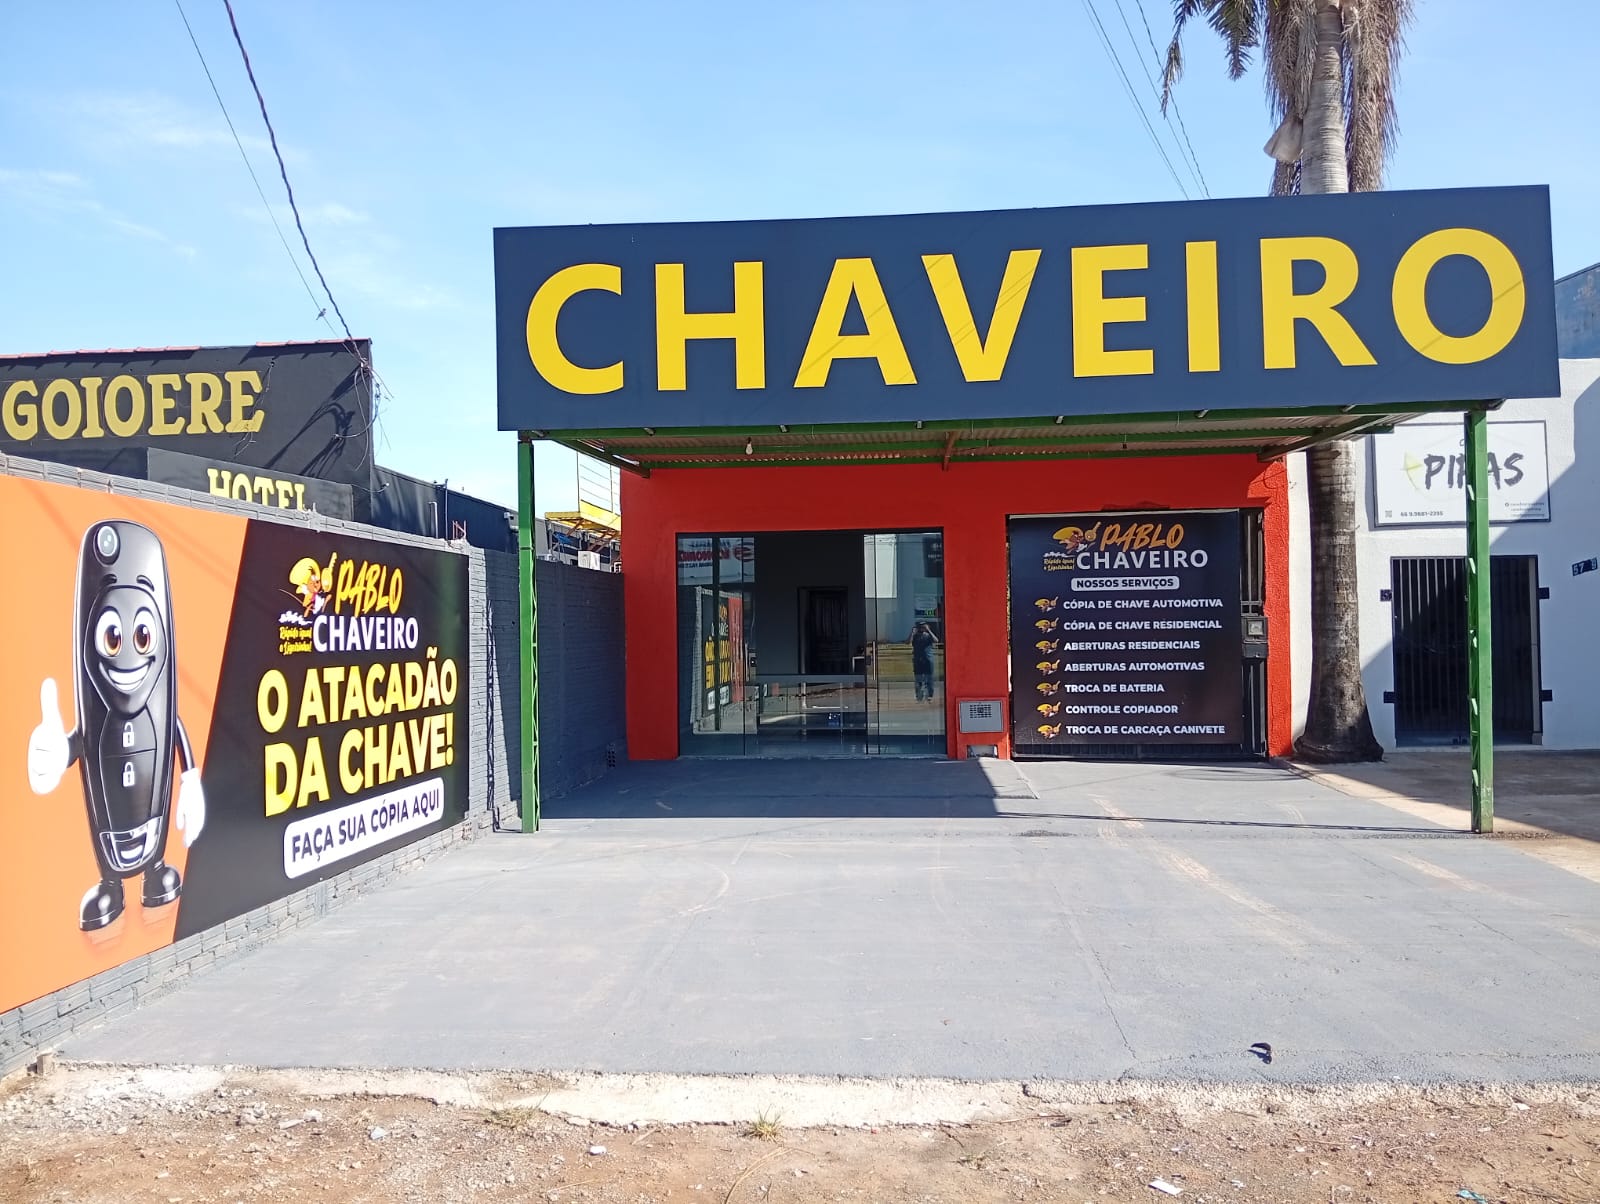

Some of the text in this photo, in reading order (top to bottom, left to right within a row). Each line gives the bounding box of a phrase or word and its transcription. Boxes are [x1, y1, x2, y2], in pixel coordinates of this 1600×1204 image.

[526, 227, 1526, 395] CHAVEIRO
[2, 370, 265, 441] GOIOERE
[1100, 522, 1184, 552] PABLO
[1076, 549, 1208, 570] CHAVEIRO
[334, 559, 403, 618] PABLO
[1076, 578, 1174, 590] NOSSOS SERVIÇOS
[1063, 598, 1223, 610] CÓPIA DE CHAVE AUTOMOTIVA
[312, 615, 419, 652] CHAVEIRO
[1063, 619, 1222, 631] CÓPIA DE CHAVE RESIDENCIAL
[1063, 641, 1201, 651] ABERTURAS RESIDENCIAIS
[1064, 661, 1205, 672] ABERTURAS AUTOMOTIVAS
[257, 646, 458, 734] O ATACADÃO
[1065, 683, 1164, 693] TROCA DE BATERIA
[1065, 704, 1179, 714] CONTROLE COPIADOR
[1065, 725, 1226, 737] TROCA DE CARCAÇA CANIVETE
[264, 712, 454, 817] DA CHAVE!
[291, 788, 440, 863] FAÇA SUA CÓPIA AQUI
